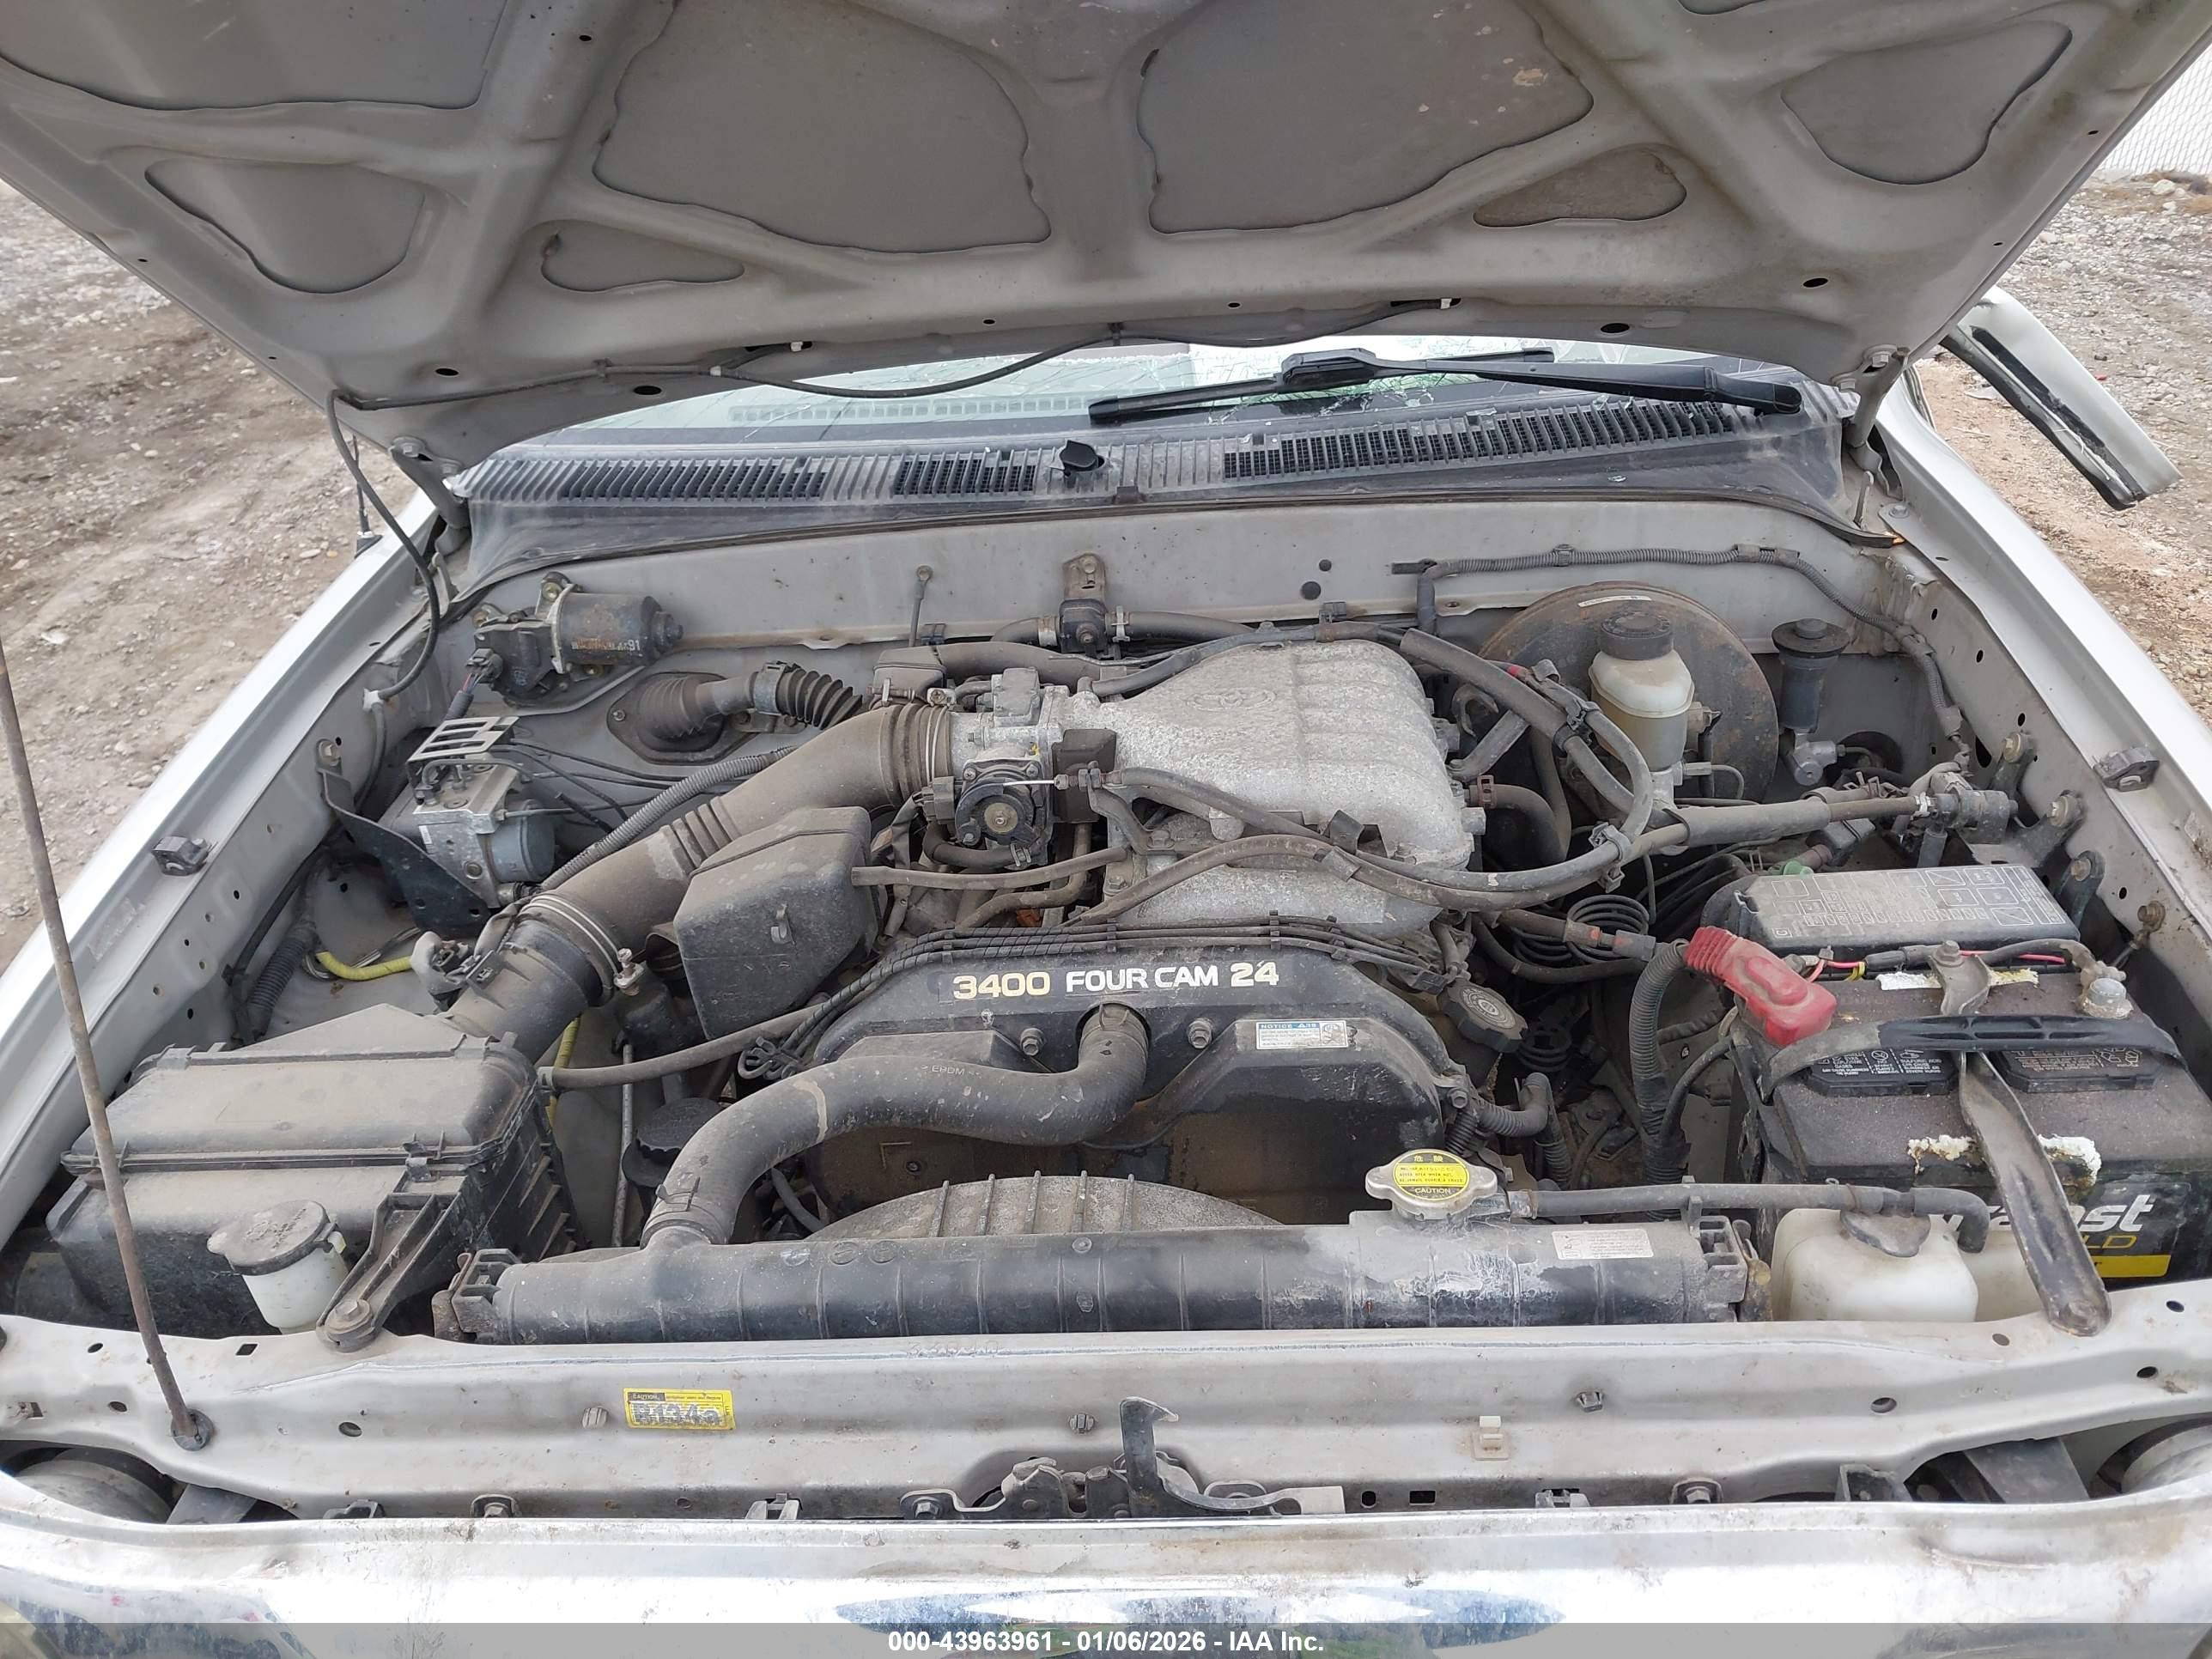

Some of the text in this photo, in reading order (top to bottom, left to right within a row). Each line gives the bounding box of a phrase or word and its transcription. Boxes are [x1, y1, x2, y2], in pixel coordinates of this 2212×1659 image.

[953, 962, 1279, 1000] 3400 FOUR CAM 24
